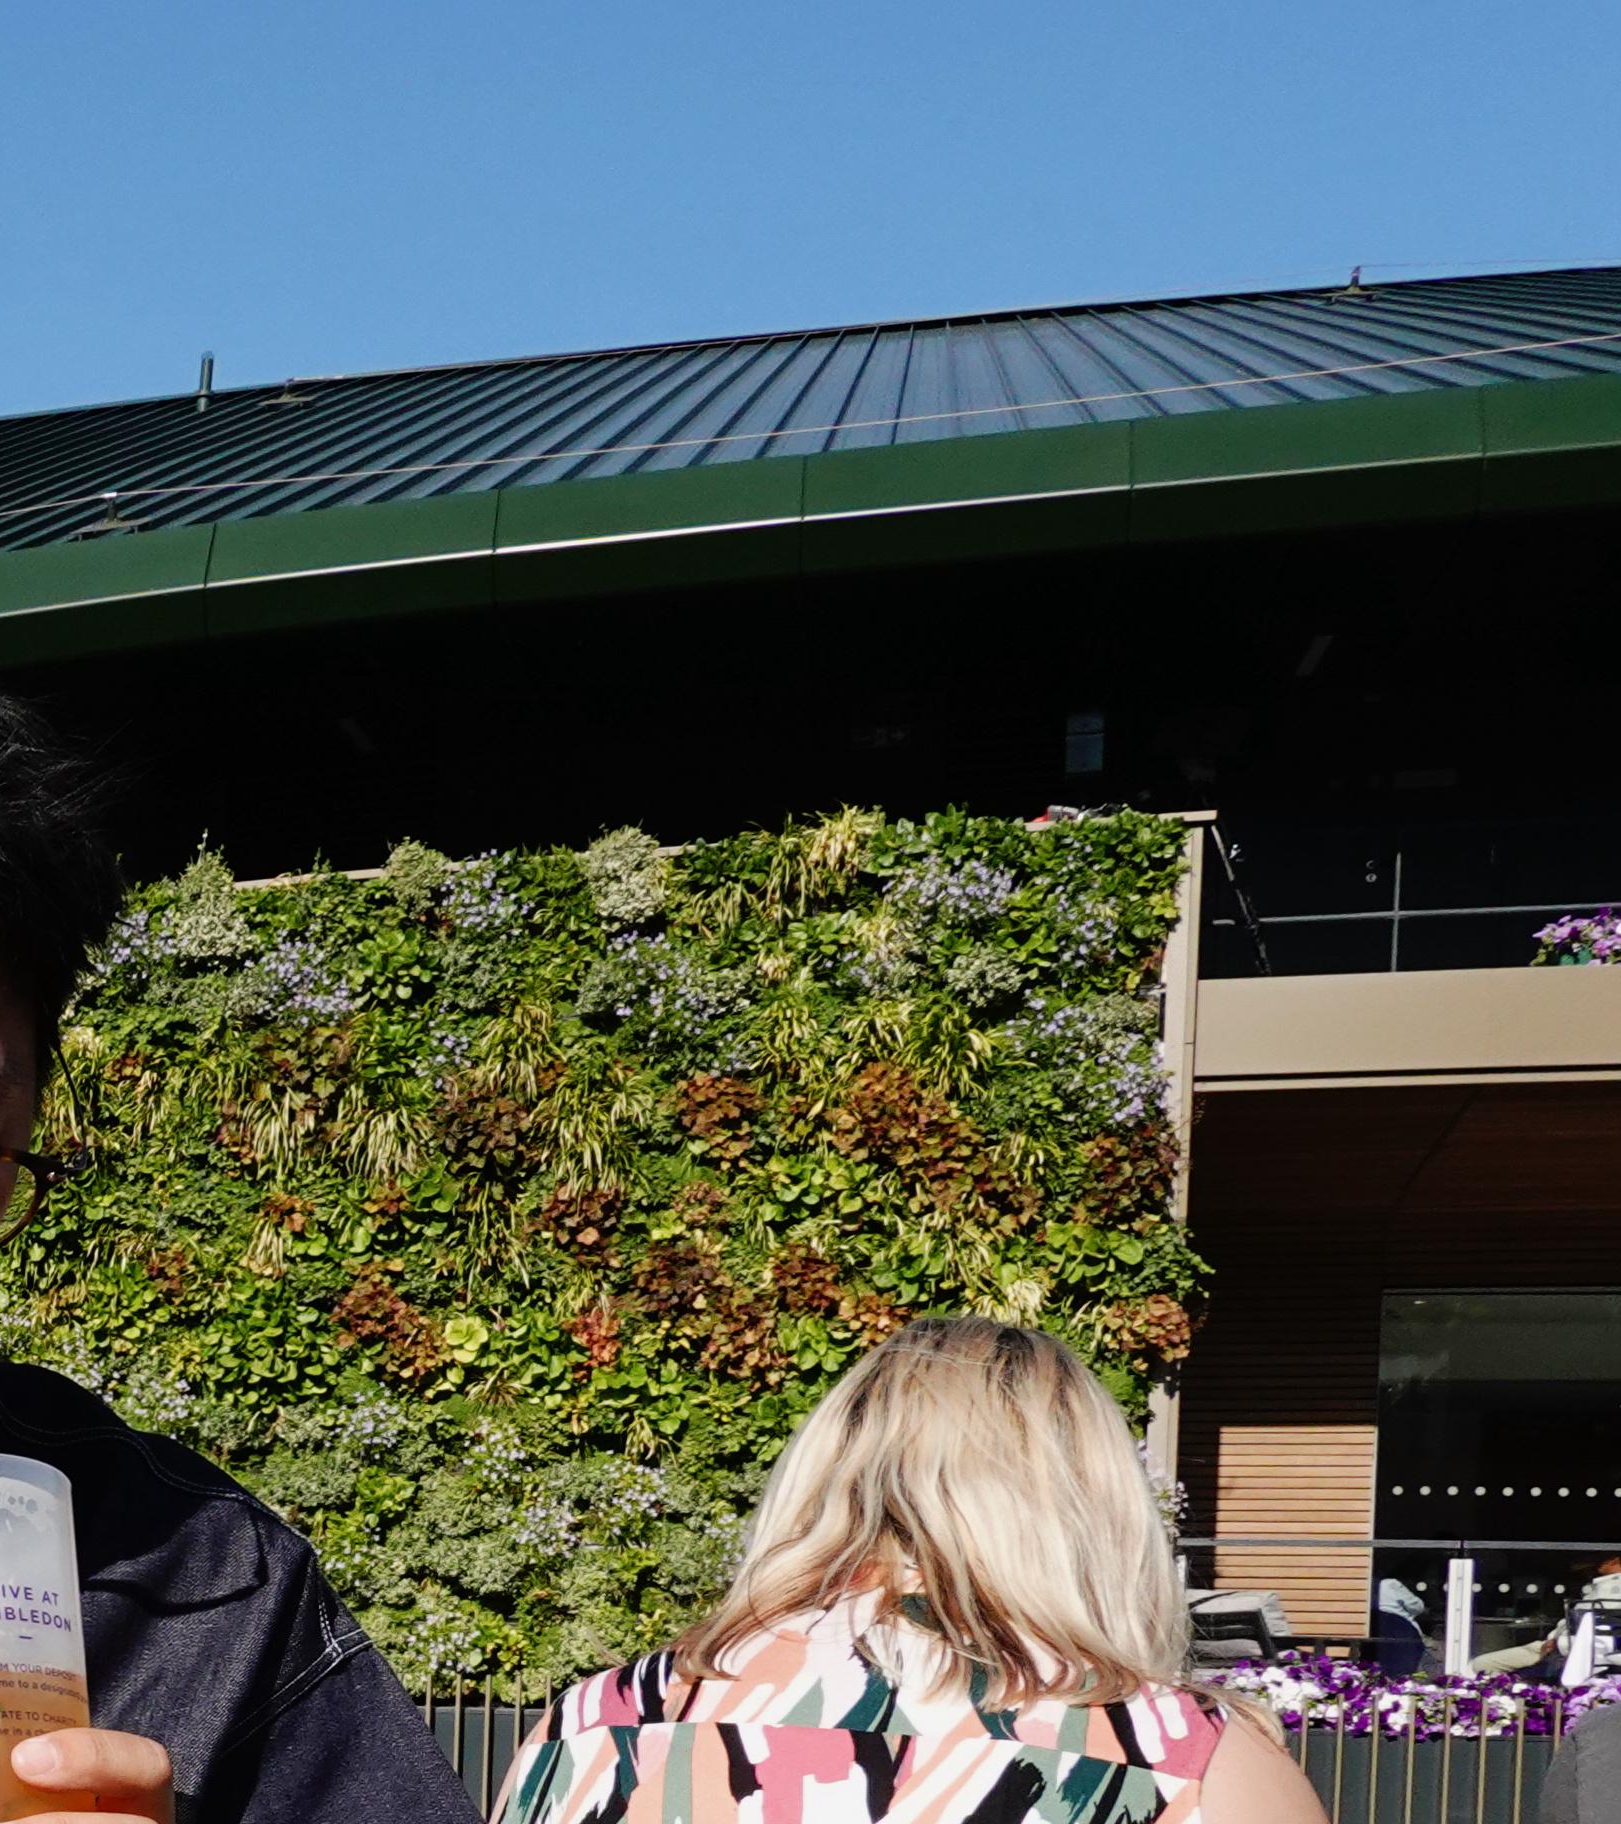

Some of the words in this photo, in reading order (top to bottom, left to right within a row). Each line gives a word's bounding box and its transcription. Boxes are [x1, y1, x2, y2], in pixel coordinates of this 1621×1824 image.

[42, 1590, 59, 1605] AT
[12, 1664, 42, 1674] YOUR
[18, 1680, 29, 1689] to
[26, 1711, 39, 1721] TO
[13, 1725, 23, 1735] in
